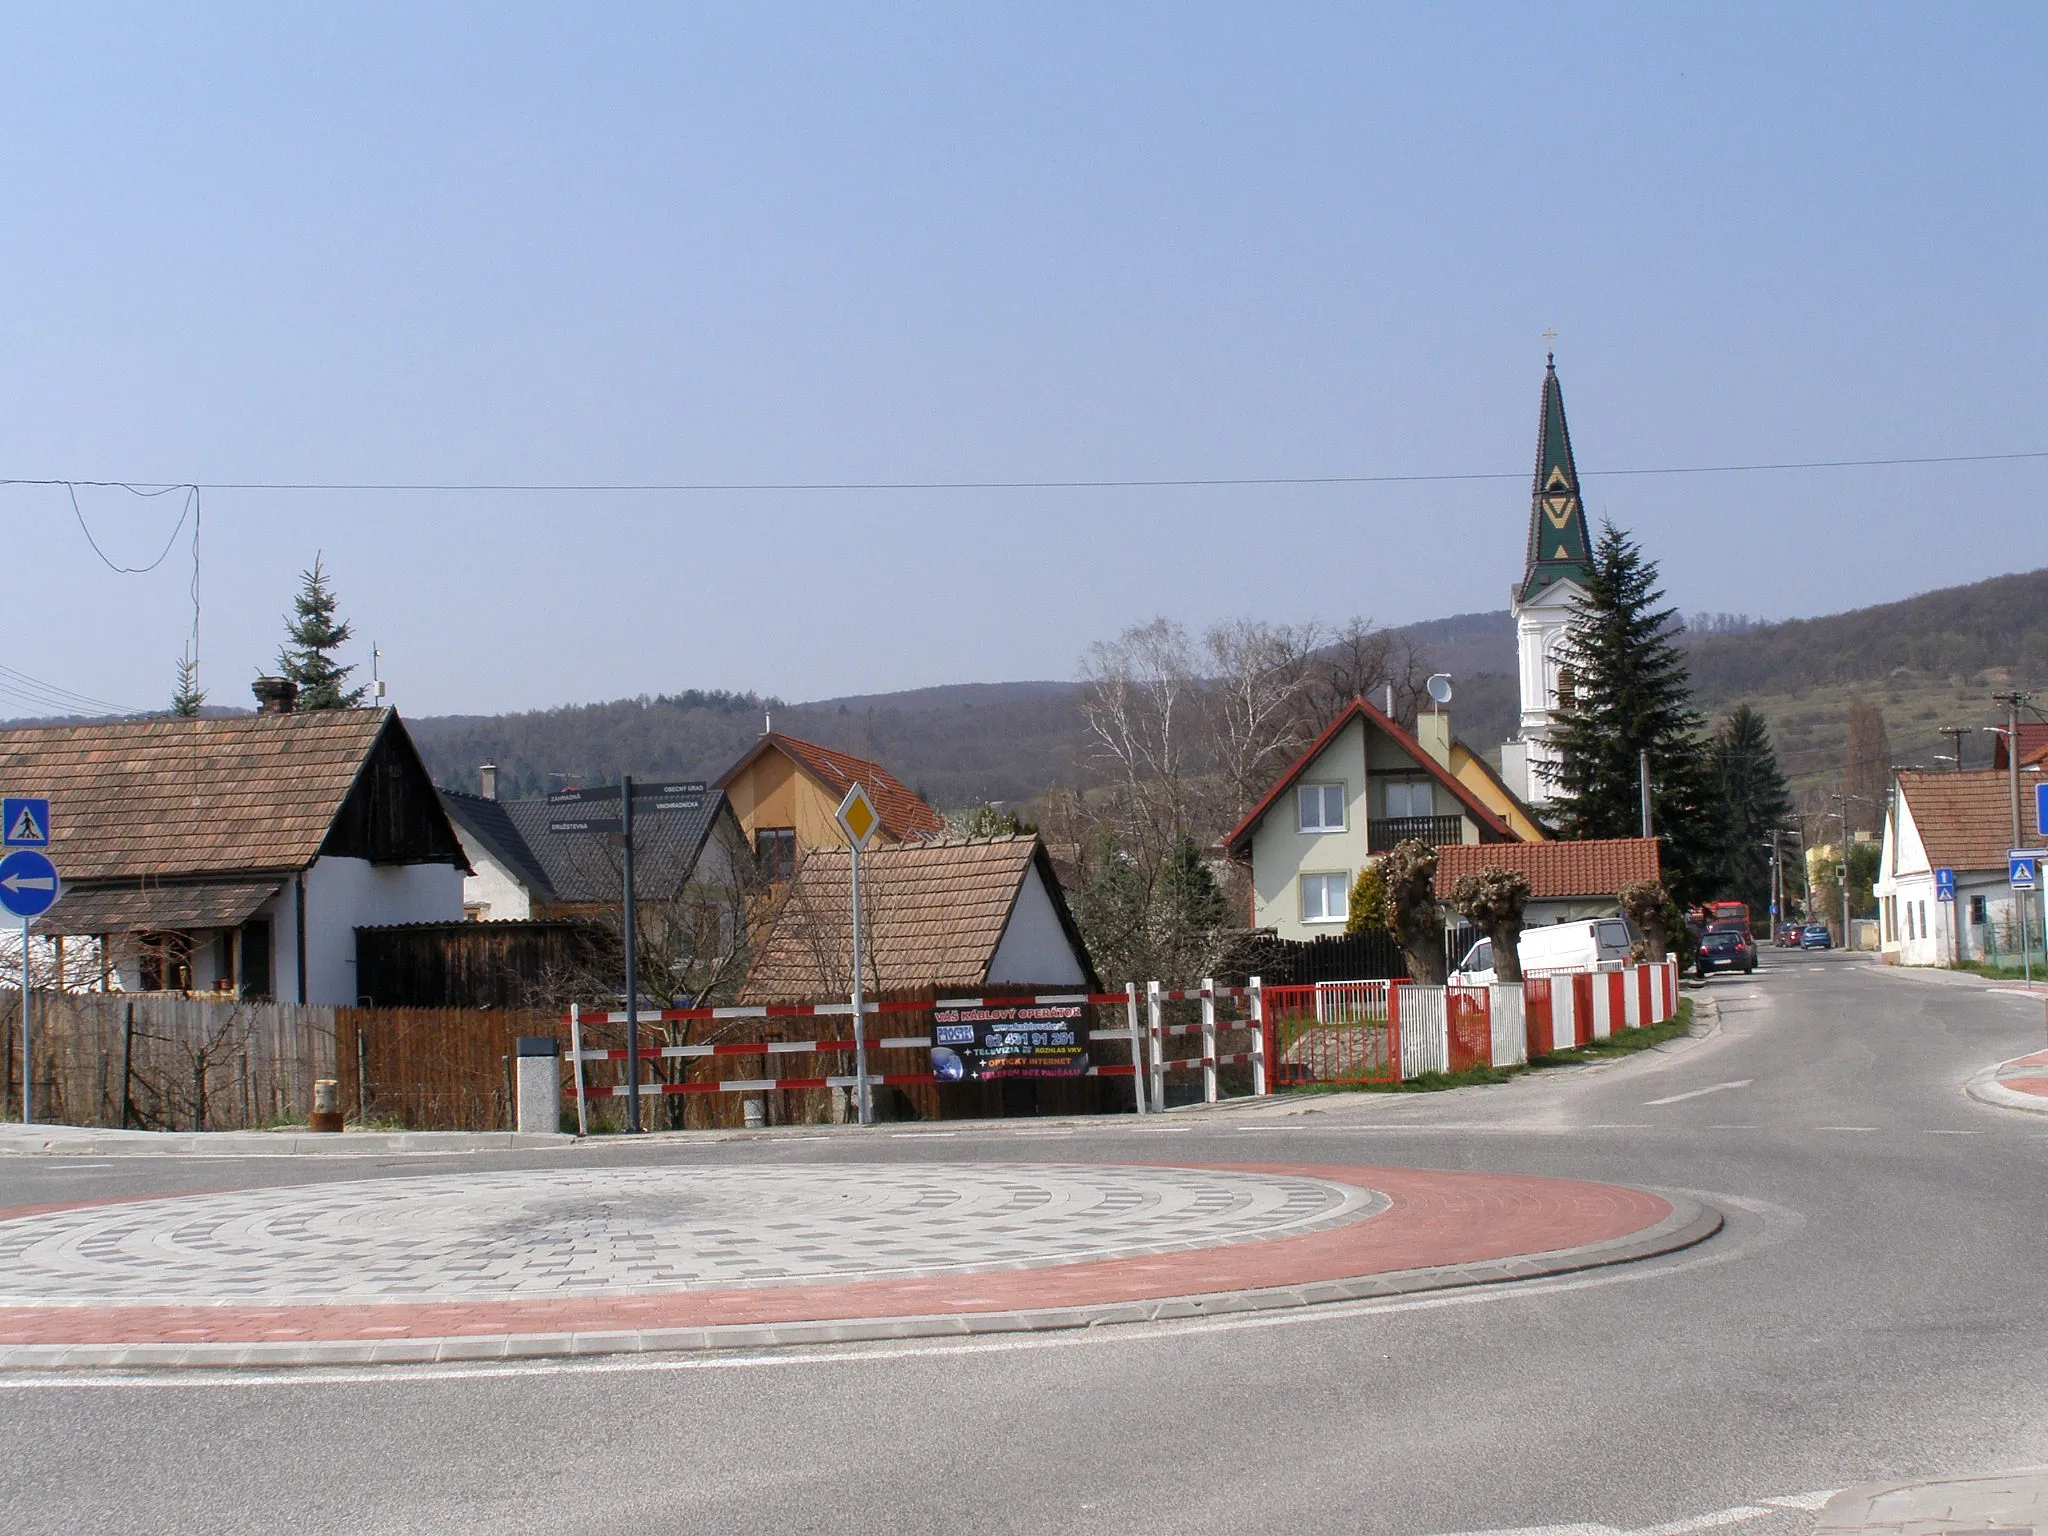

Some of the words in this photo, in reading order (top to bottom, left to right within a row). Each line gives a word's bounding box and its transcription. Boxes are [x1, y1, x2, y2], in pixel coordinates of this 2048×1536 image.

[934, 1010, 959, 1022] VÁŠ
[961, 1008, 1015, 1021] KÁBLOVÝ
[1018, 1007, 1081, 1018] OPERÁTOR
[1032, 1032, 1047, 1045] 91
[1029, 1057, 1072, 1065] INTERNET
